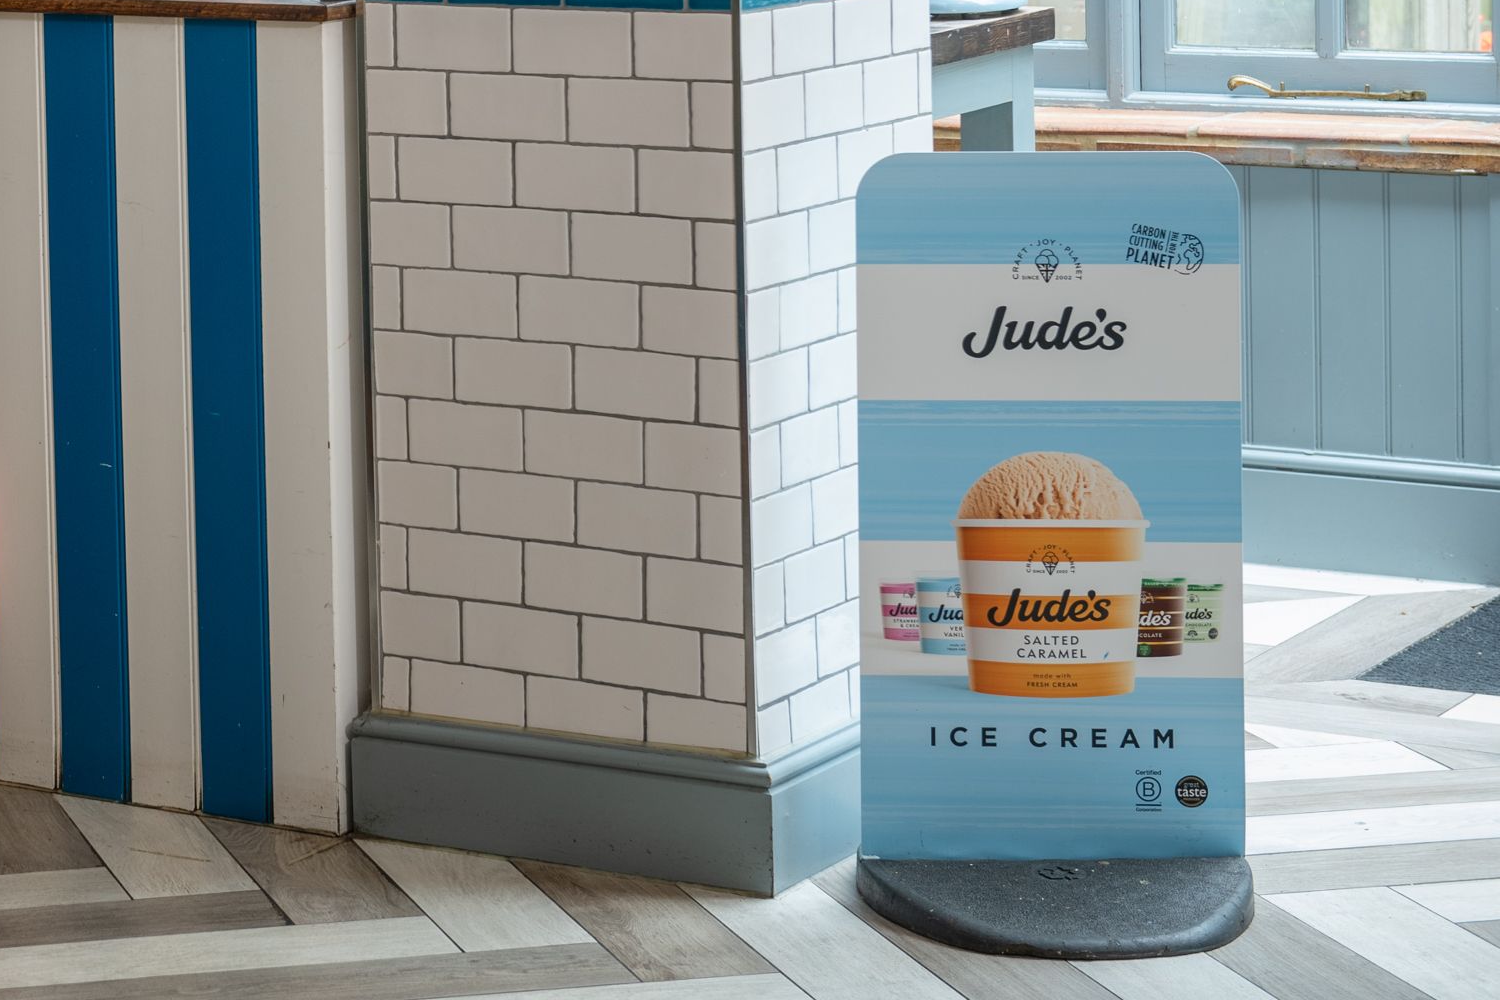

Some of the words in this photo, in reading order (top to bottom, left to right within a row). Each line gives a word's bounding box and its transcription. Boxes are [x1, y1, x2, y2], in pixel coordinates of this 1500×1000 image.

[1132, 223, 1167, 240] CARBON
[1171, 231, 1179, 242] THE
[1129, 235, 1164, 251] CUTTING
[1012, 247, 1028, 280] CRAFT
[1036, 238, 1056, 247] JOY
[1064, 246, 1083, 280] PLANET
[1126, 247, 1174, 270] PLANET
[962, 305, 1127, 358] Jude's
[889, 602, 917, 617] Jud
[928, 604, 964, 623] Jud
[987, 588, 1111, 627] Jude's
[1185, 608, 1213, 620] de's
[1139, 610, 1171, 626] de's
[1023, 635, 1079, 646] SALTED
[1016, 648, 1087, 659] CARAMEL
[930, 727, 997, 747] ICE
[1029, 727, 1174, 749] CREAM
[1177, 788, 1207, 797] taste
